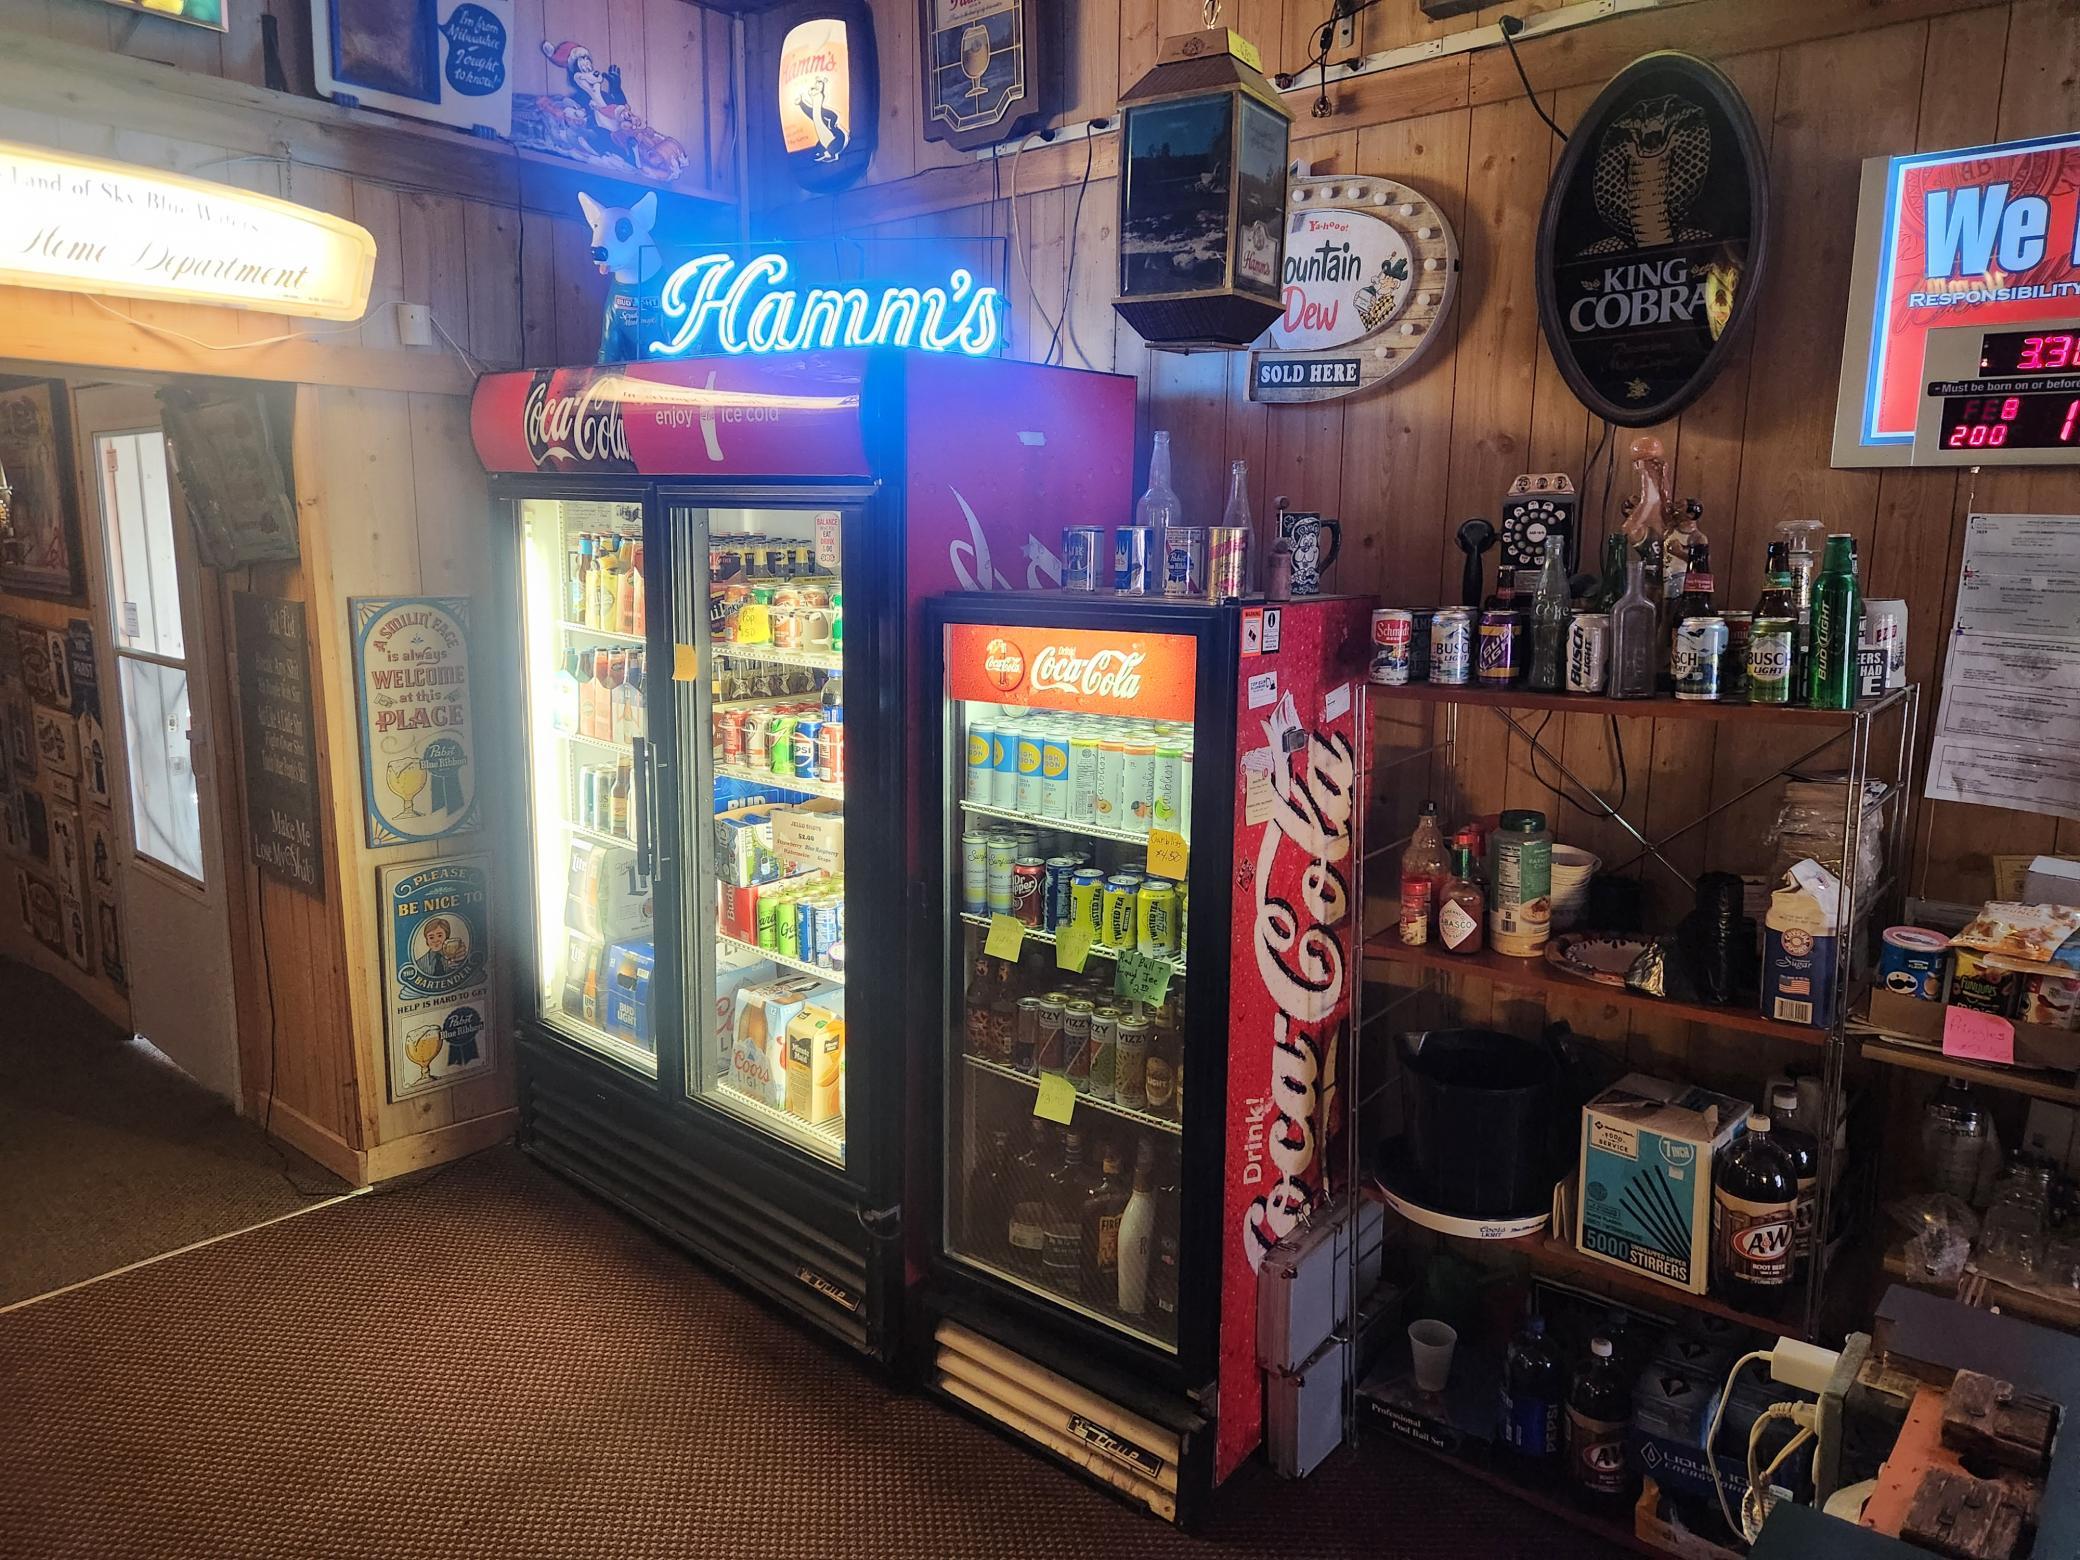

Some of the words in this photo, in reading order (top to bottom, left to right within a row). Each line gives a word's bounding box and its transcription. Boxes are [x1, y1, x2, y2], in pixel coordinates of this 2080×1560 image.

[1925, 181, 2051, 280] We
[22, 224, 108, 265] Home
[134, 241, 309, 290] Department
[1283, 239, 1362, 285] ountain
[1603, 257, 1689, 294] KING
[650, 252, 998, 355] Hamm's
[1908, 281, 2080, 311] RESPONSIBILITY
[1282, 286, 1340, 333] Dew
[1260, 364, 1305, 383] SOLD
[1309, 362, 1358, 382] HERE
[1970, 381, 1985, 392] be
[1987, 380, 2012, 392] born
[2014, 380, 2029, 390] on
[2031, 380, 2044, 390] or
[654, 409, 693, 428] enjoy
[387, 650, 400, 663] is
[402, 646, 448, 666] always
[371, 665, 466, 690] WELCOME
[1030, 645, 1147, 700] Coca-Cola
[1753, 666, 1784, 675] LIGHT
[399, 690, 414, 704] at
[415, 688, 442, 704] this
[375, 704, 465, 732] PLACE
[429, 743, 456, 759] Pabst
[271, 807, 296, 841] Make
[295, 818, 312, 849] Me
[412, 867, 467, 887] PLEASE
[397, 900, 419, 918] BE
[423, 894, 460, 914] NICE
[1115, 896, 1125, 910] TEA
[1112, 909, 1123, 941] TWISTED
[414, 965, 474, 990] BARTENDER
[396, 1002, 421, 1016] HELP
[422, 999, 432, 1010] IS
[433, 994, 458, 1009] HARD
[458, 992, 470, 1002] TO
[618, 1002, 636, 1016] BUD
[447, 1014, 473, 1029] Pabst
[617, 1009, 638, 1029] LIGHT
[1118, 1031, 1147, 1044] VIZZY
[733, 1049, 770, 1083] Coors
[1243, 1095, 1267, 1186] Drink!
[1599, 1138, 1629, 1153] SERVICE
[1605, 1132, 1623, 1143] FOOD
[1586, 1229, 1629, 1260] 5000
[1747, 1226, 1790, 1255] A&W
[1629, 1247, 1688, 1281] STIRRERS
[1371, 1402, 1422, 1429] Professional
[1391, 1420, 1412, 1437] Pool
[1412, 1428, 1430, 1443] Ball
[1430, 1435, 1445, 1449] Set
